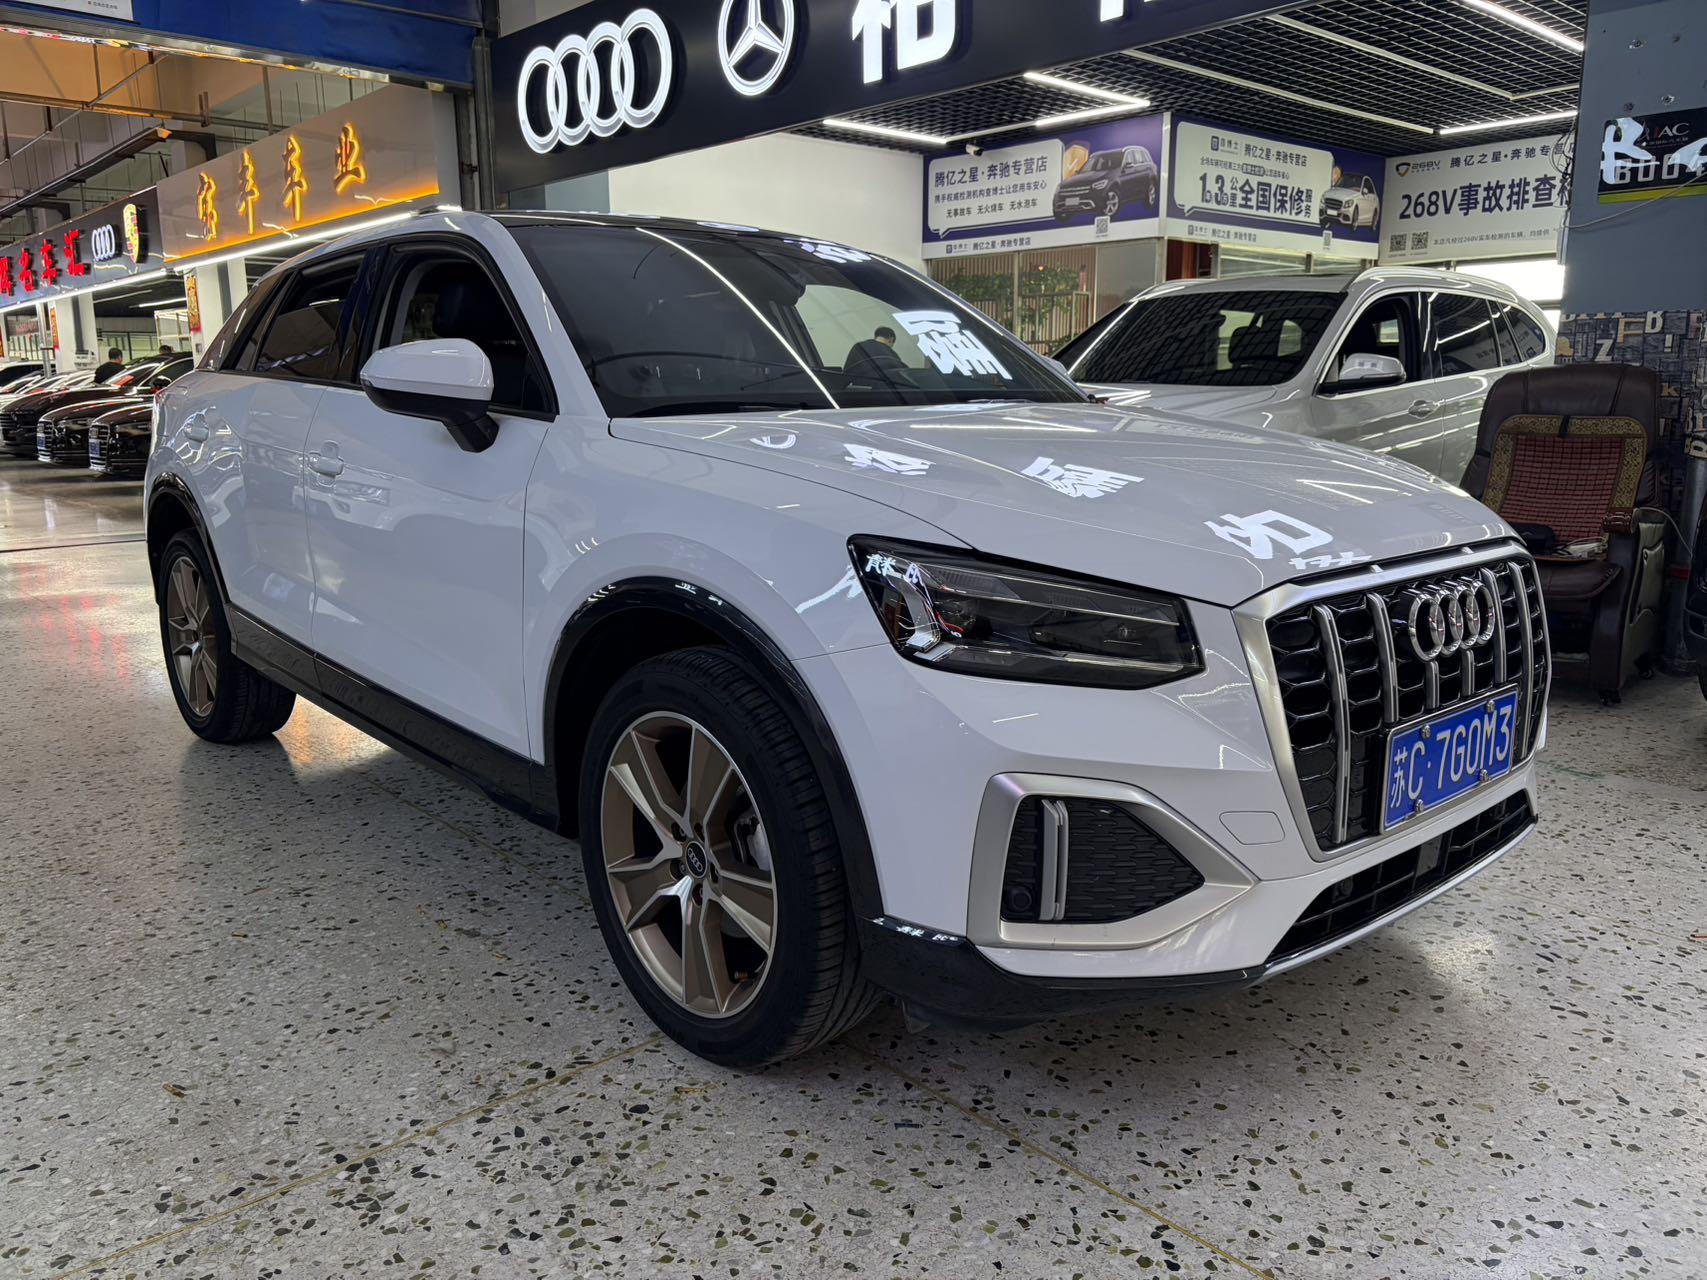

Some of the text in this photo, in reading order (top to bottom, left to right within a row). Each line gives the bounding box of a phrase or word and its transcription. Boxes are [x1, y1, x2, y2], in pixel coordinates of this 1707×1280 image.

[934, 155, 1048, 188] 腾亿之星·奔驰专营店
